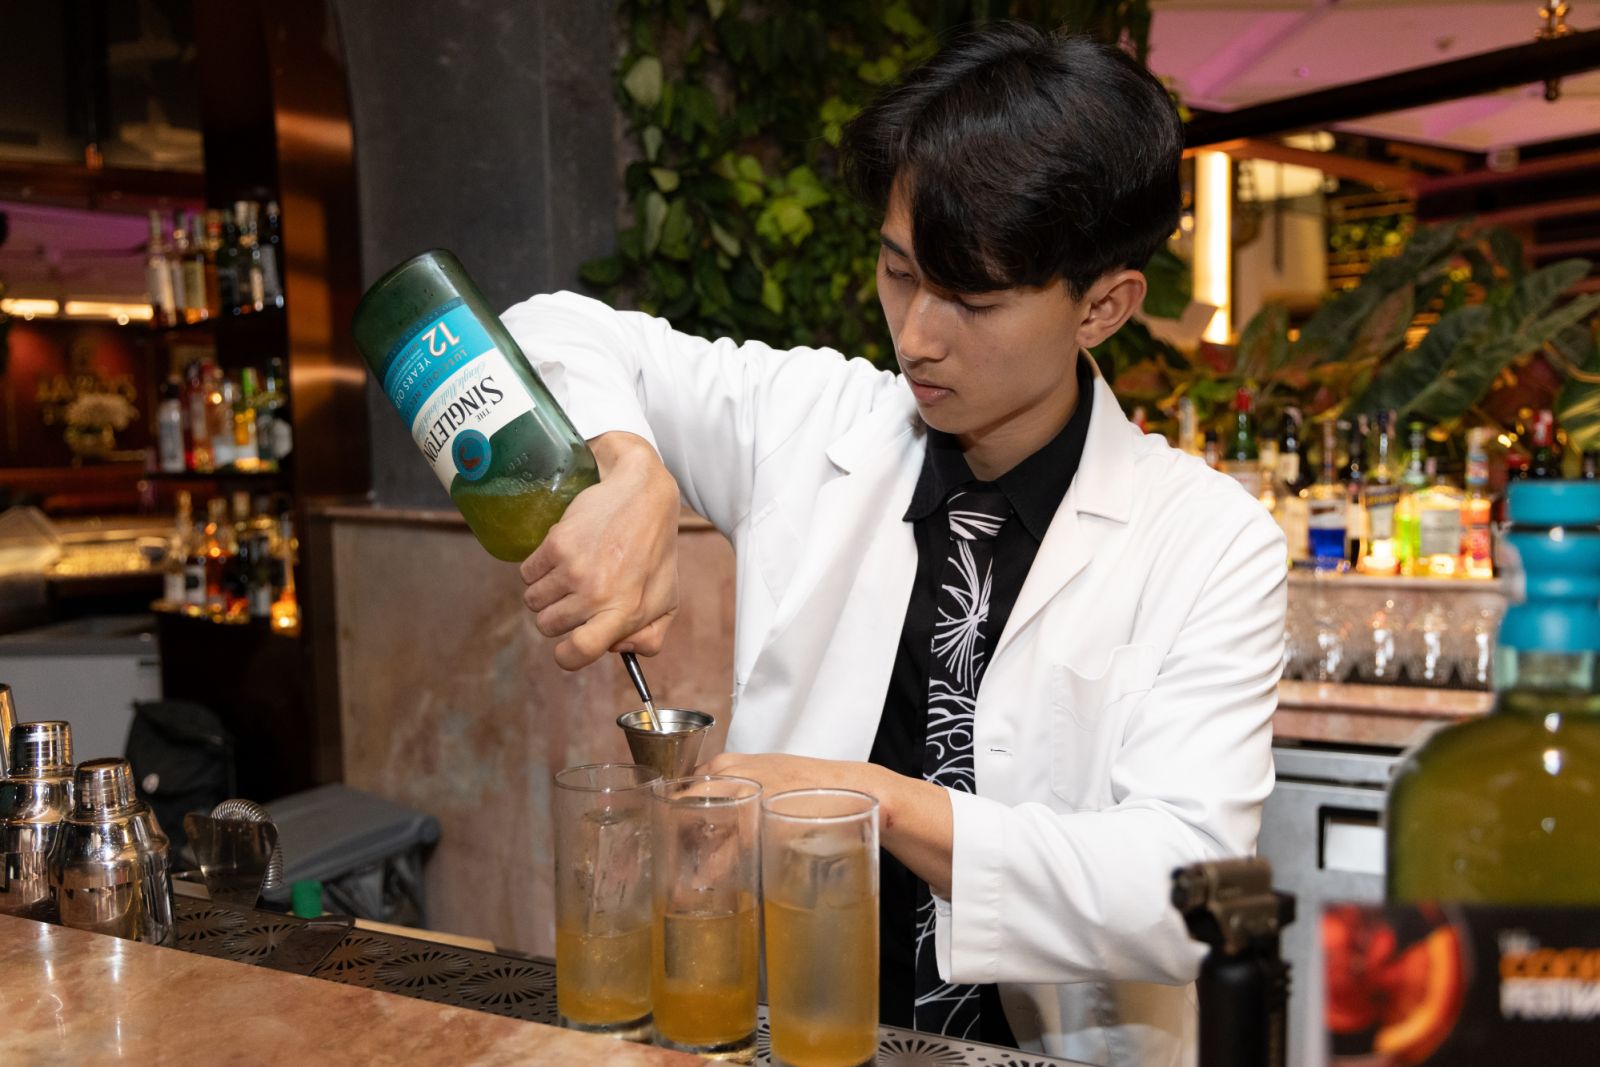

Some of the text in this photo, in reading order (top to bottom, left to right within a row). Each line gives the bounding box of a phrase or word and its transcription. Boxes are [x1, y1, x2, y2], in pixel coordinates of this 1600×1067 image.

[421, 321, 461, 357] 12
[402, 356, 431, 390] YEARS
[476, 408, 492, 423] THE
